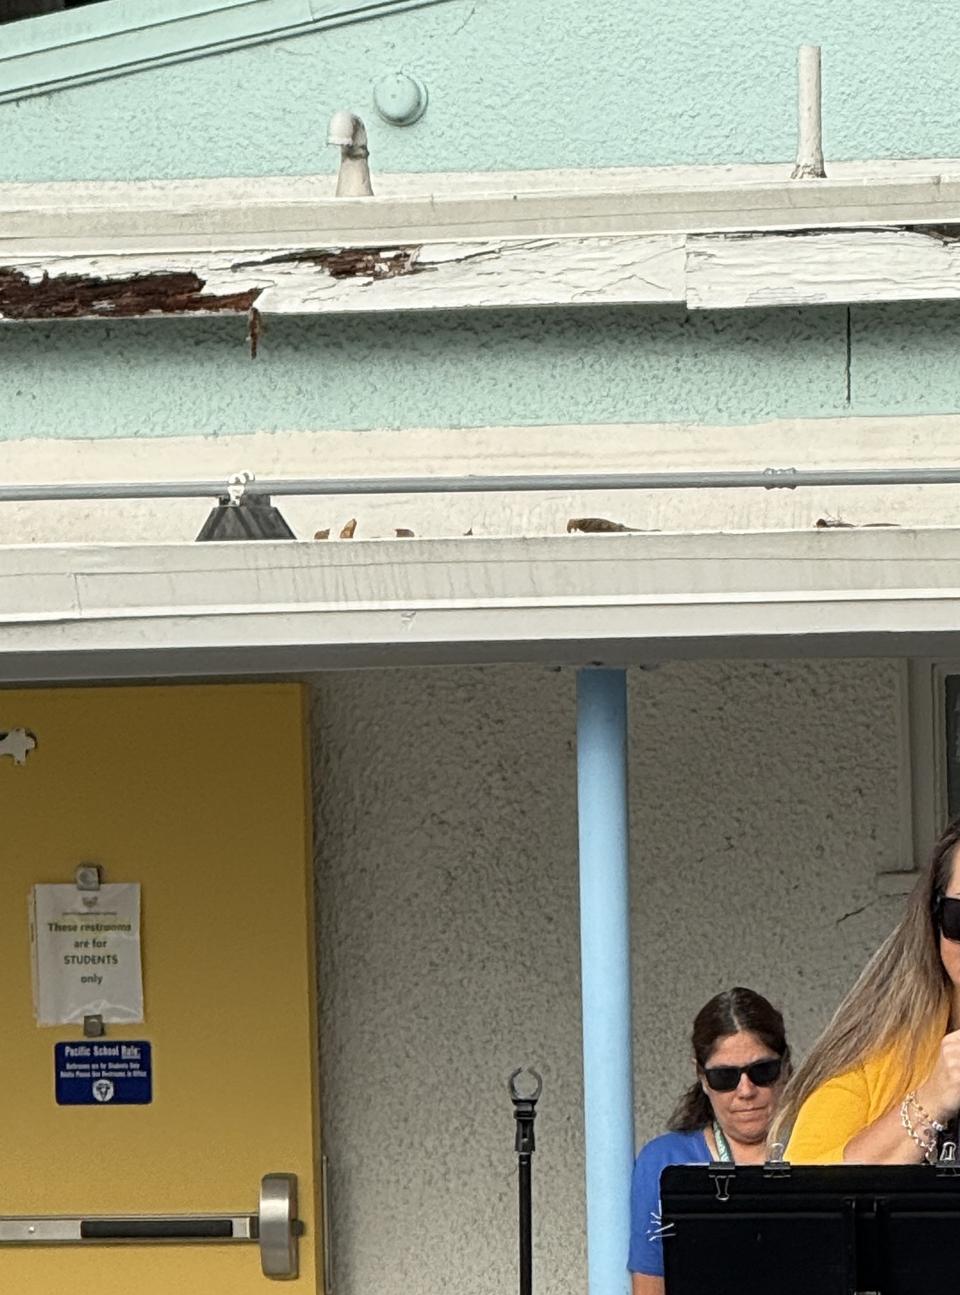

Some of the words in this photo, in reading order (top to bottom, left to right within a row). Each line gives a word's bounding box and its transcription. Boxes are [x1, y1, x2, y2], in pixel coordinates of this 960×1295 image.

[48, 923, 78, 932] These
[74, 940, 90, 948] are
[92, 938, 108, 948] for
[63, 954, 119, 965] STUDENTS
[80, 974, 103, 985] only
[64, 1045, 91, 1057] Pacific
[93, 1045, 119, 1056] School
